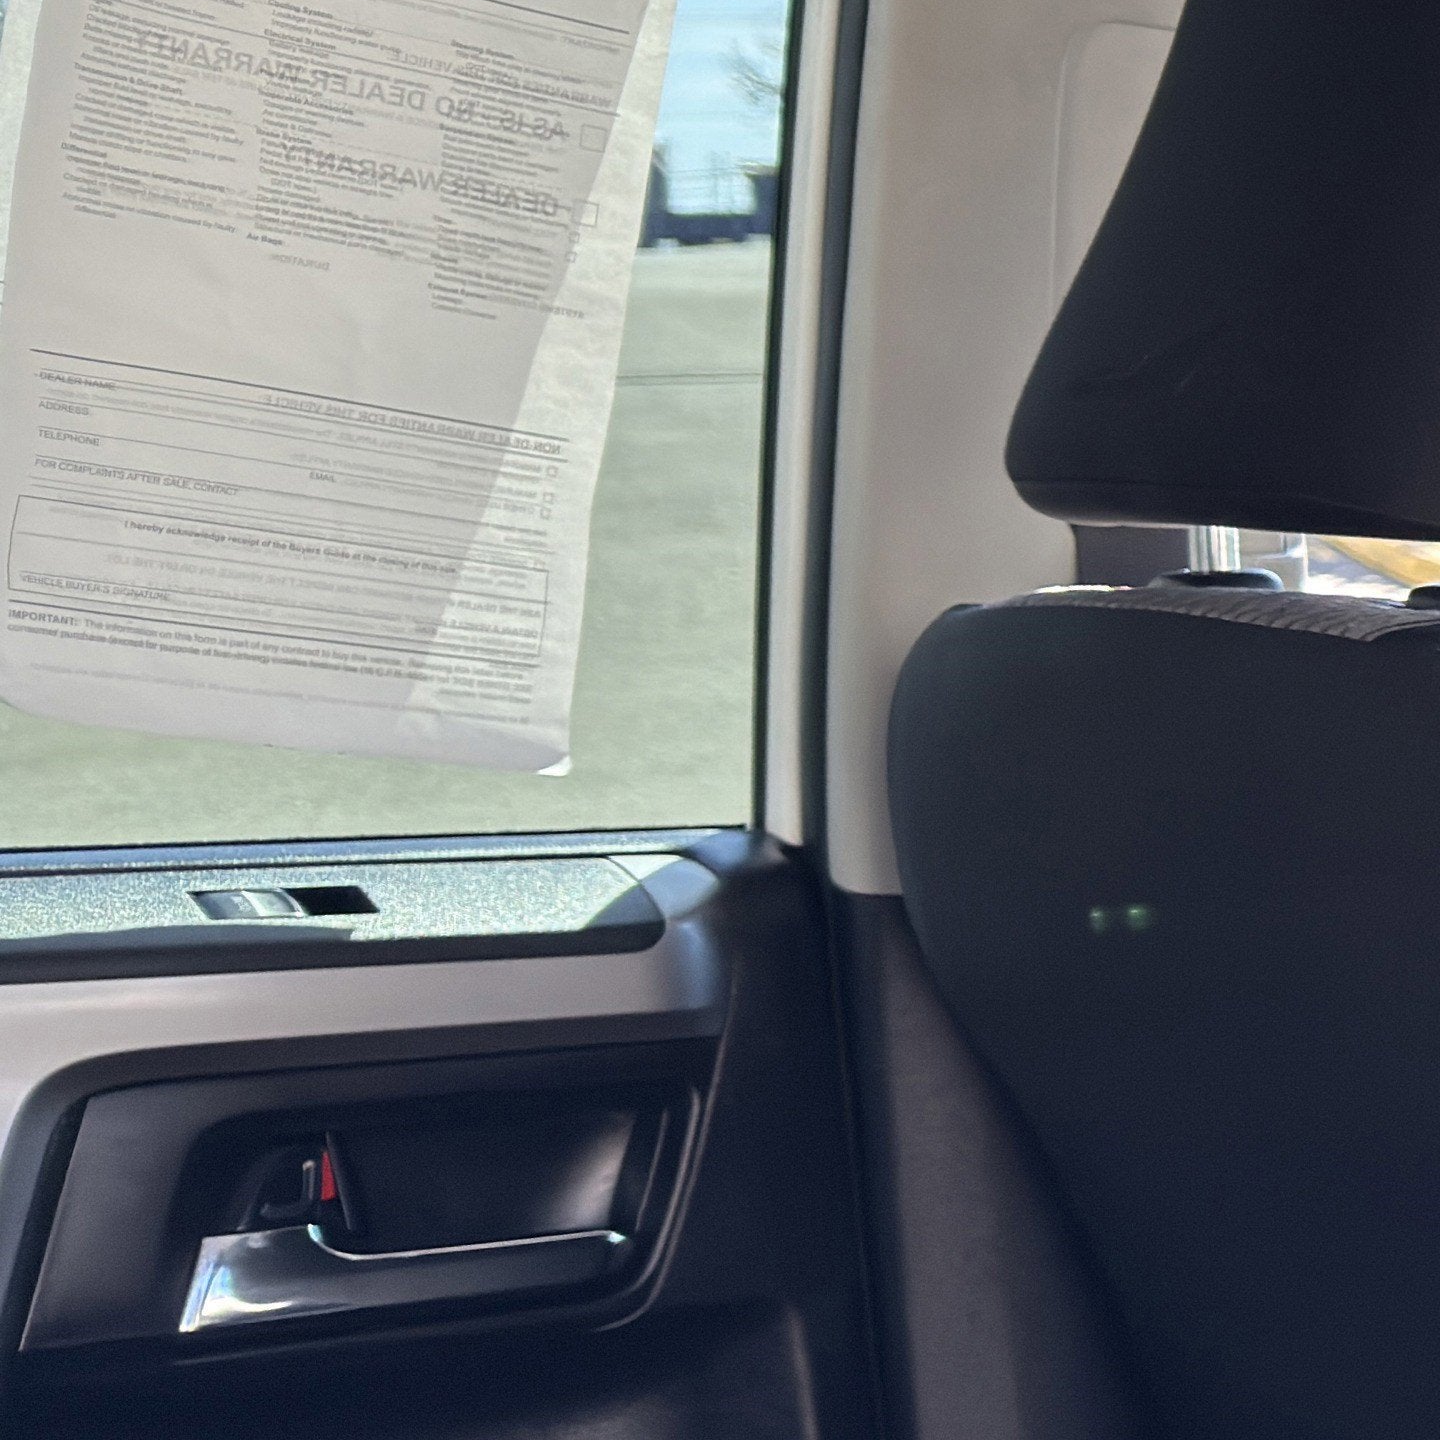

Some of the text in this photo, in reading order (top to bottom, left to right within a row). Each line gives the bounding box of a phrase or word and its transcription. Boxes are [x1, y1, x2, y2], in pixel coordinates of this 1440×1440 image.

[302, 6, 333, 21] System
[37, 398, 89, 416] ADDRESS
[37, 428, 100, 446] TELEPHONE
[34, 457, 56, 470] FOR
[58, 461, 124, 480] COMPLAINTS
[125, 471, 161, 485] AFTER
[192, 481, 239, 497] CONTACT
[129, 520, 163, 533] hereby
[165, 525, 225, 542] acknowledge
[10, 609, 78, 628] IMPORTANT:
